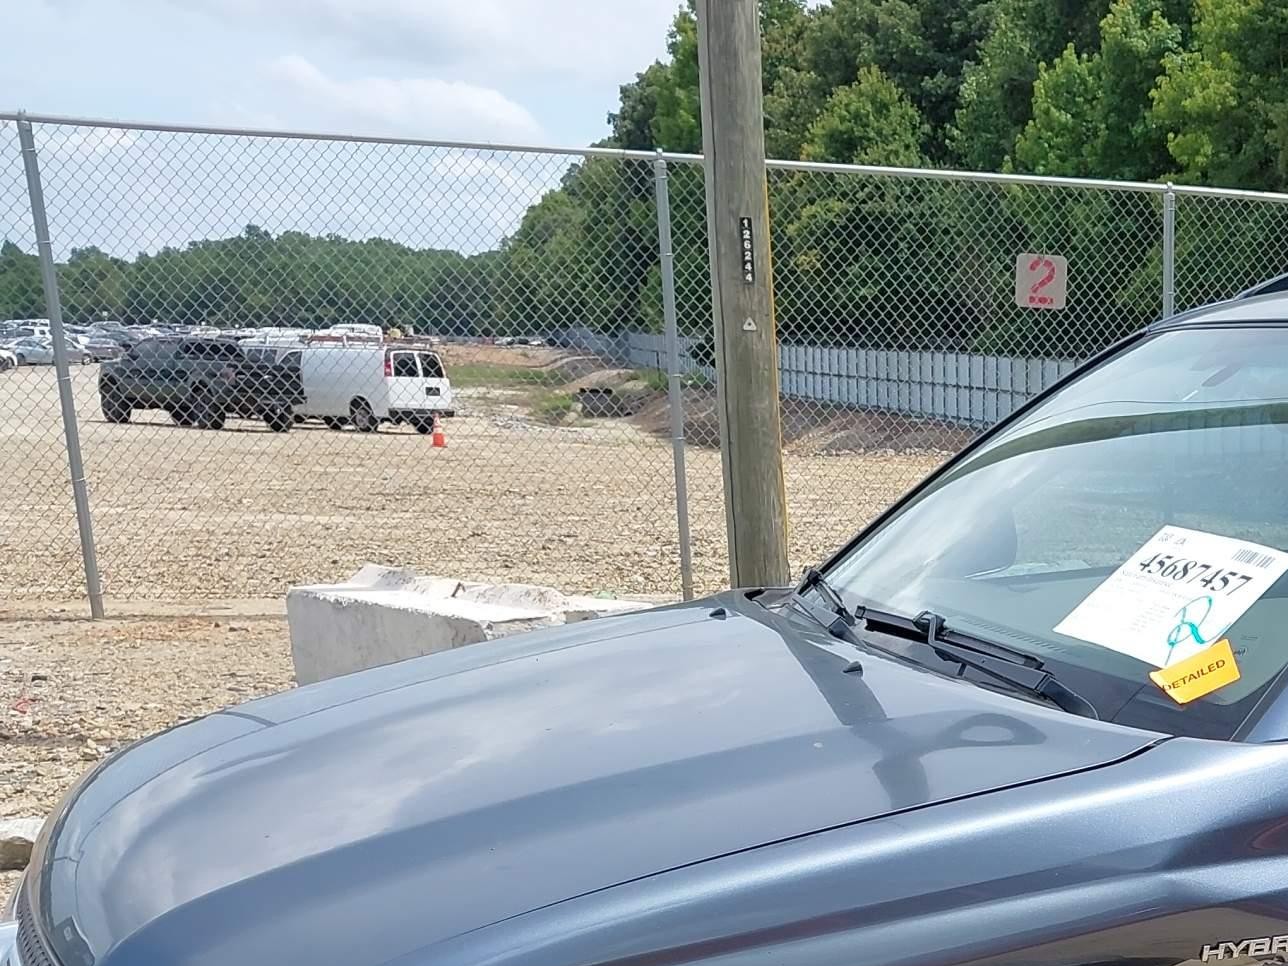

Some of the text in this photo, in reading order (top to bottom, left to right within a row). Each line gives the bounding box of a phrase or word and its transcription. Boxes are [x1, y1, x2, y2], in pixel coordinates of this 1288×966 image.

[742, 218, 753, 282] 126244
[1029, 258, 1056, 304] 2
[1140, 552, 1253, 596] 45687457
[1162, 659, 1227, 691] DETAILED
